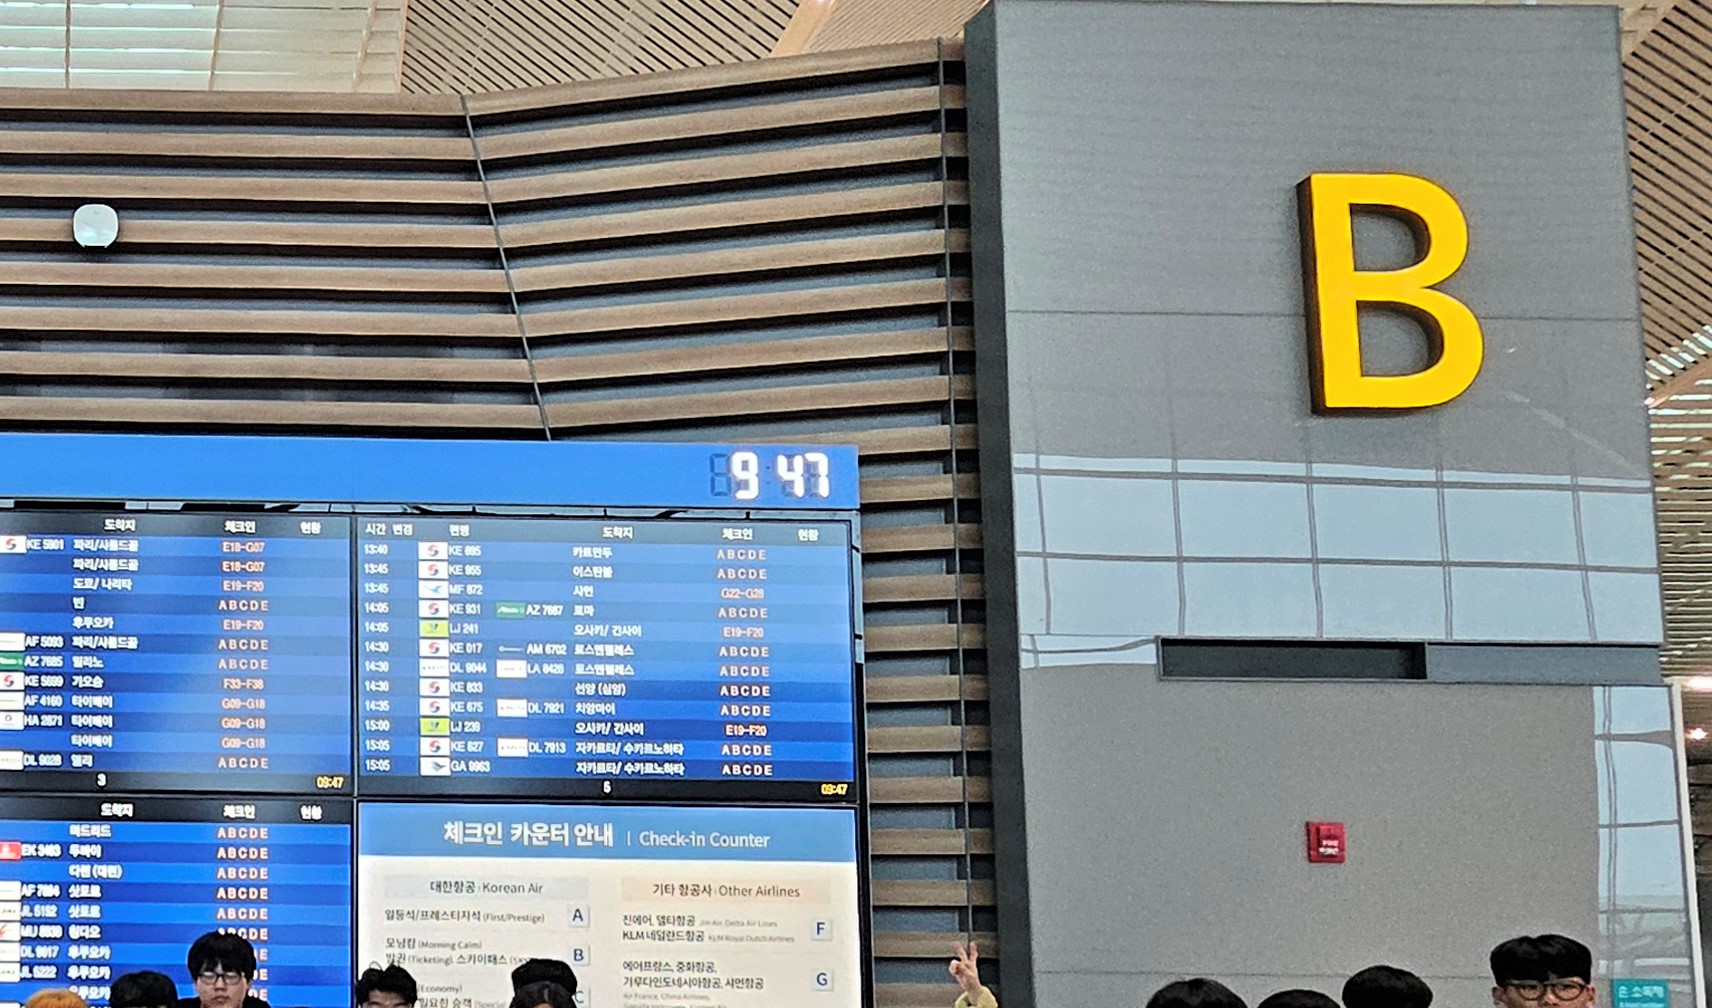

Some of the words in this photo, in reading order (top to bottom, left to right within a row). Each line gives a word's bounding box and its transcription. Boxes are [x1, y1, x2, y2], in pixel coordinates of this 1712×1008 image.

[1299, 172, 1485, 416] B
[365, 524, 386, 535] 시간
[392, 524, 413, 536] 변경
[603, 526, 633, 539] 도착지
[722, 528, 753, 540] 체크인
[449, 604, 463, 615] KE
[450, 643, 464, 654] KE
[444, 821, 503, 844] 체크인
[510, 822, 570, 846] 카운터
[574, 823, 613, 847] 안내
[639, 831, 706, 847] Check-in
[709, 832, 771, 848] Counter
[430, 881, 475, 894] 대한항공
[483, 882, 525, 894] Korean
[528, 883, 543, 894] Air
[652, 884, 674, 896] 기타
[679, 884, 712, 897] 항공사
[719, 885, 752, 897] Other
[756, 886, 800, 898] Airlines
[572, 909, 584, 922] A
[656, 915, 695, 927] 델타항공
[816, 923, 825, 935] F
[623, 930, 644, 940] KLM
[646, 931, 704, 942] 네덜란드항공
[418, 941, 456, 950] (Morning
[458, 940, 482, 949] Calm)
[457, 953, 507, 965] 스카이패스
[574, 949, 584, 961] B
[817, 973, 827, 986] G
